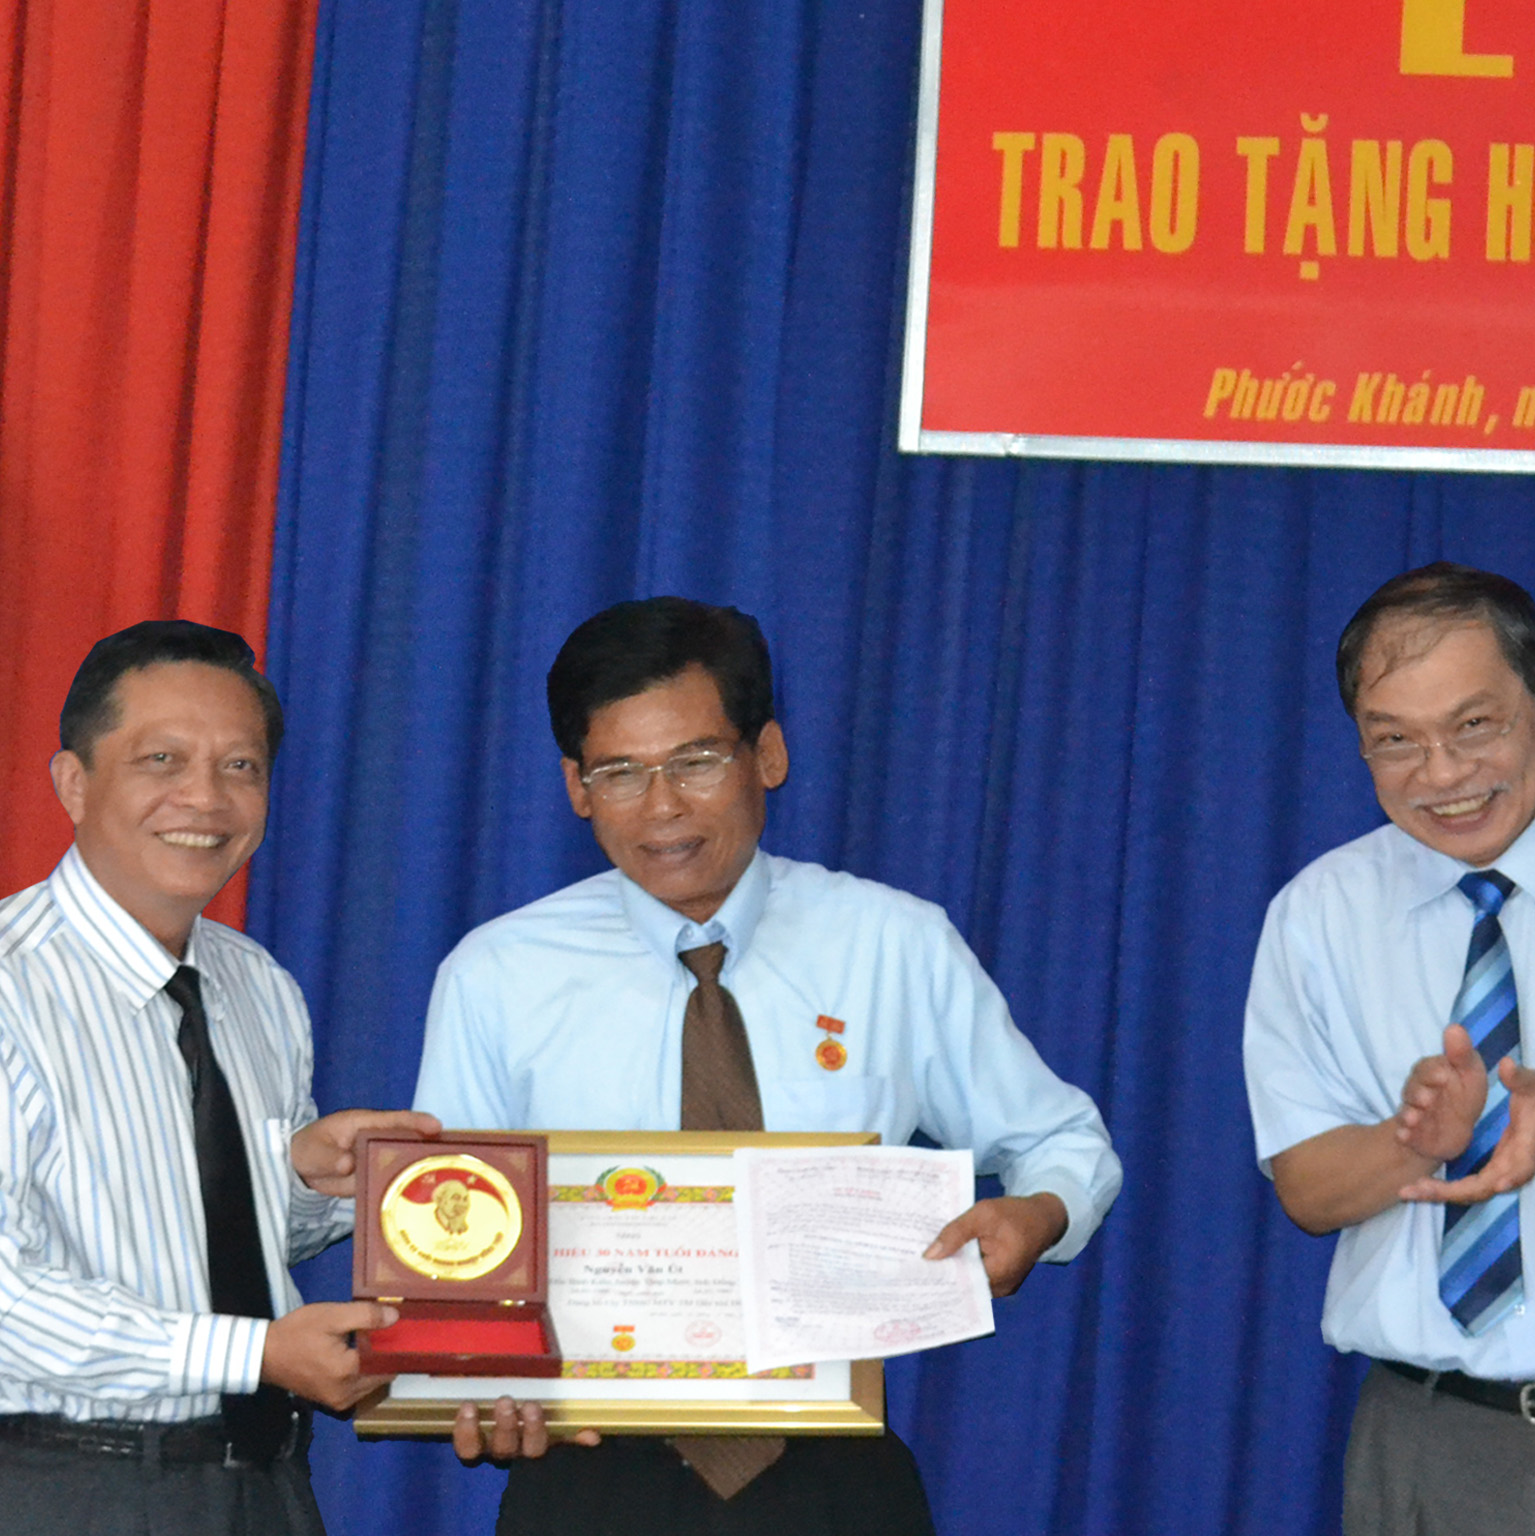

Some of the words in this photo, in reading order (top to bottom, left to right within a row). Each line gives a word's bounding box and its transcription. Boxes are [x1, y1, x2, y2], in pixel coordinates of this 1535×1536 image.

[991, 131, 1202, 255] TRAO
[1235, 112, 1455, 282] TẶNG
[1203, 362, 1337, 425] Phước
[1347, 368, 1500, 437] Khánh,
